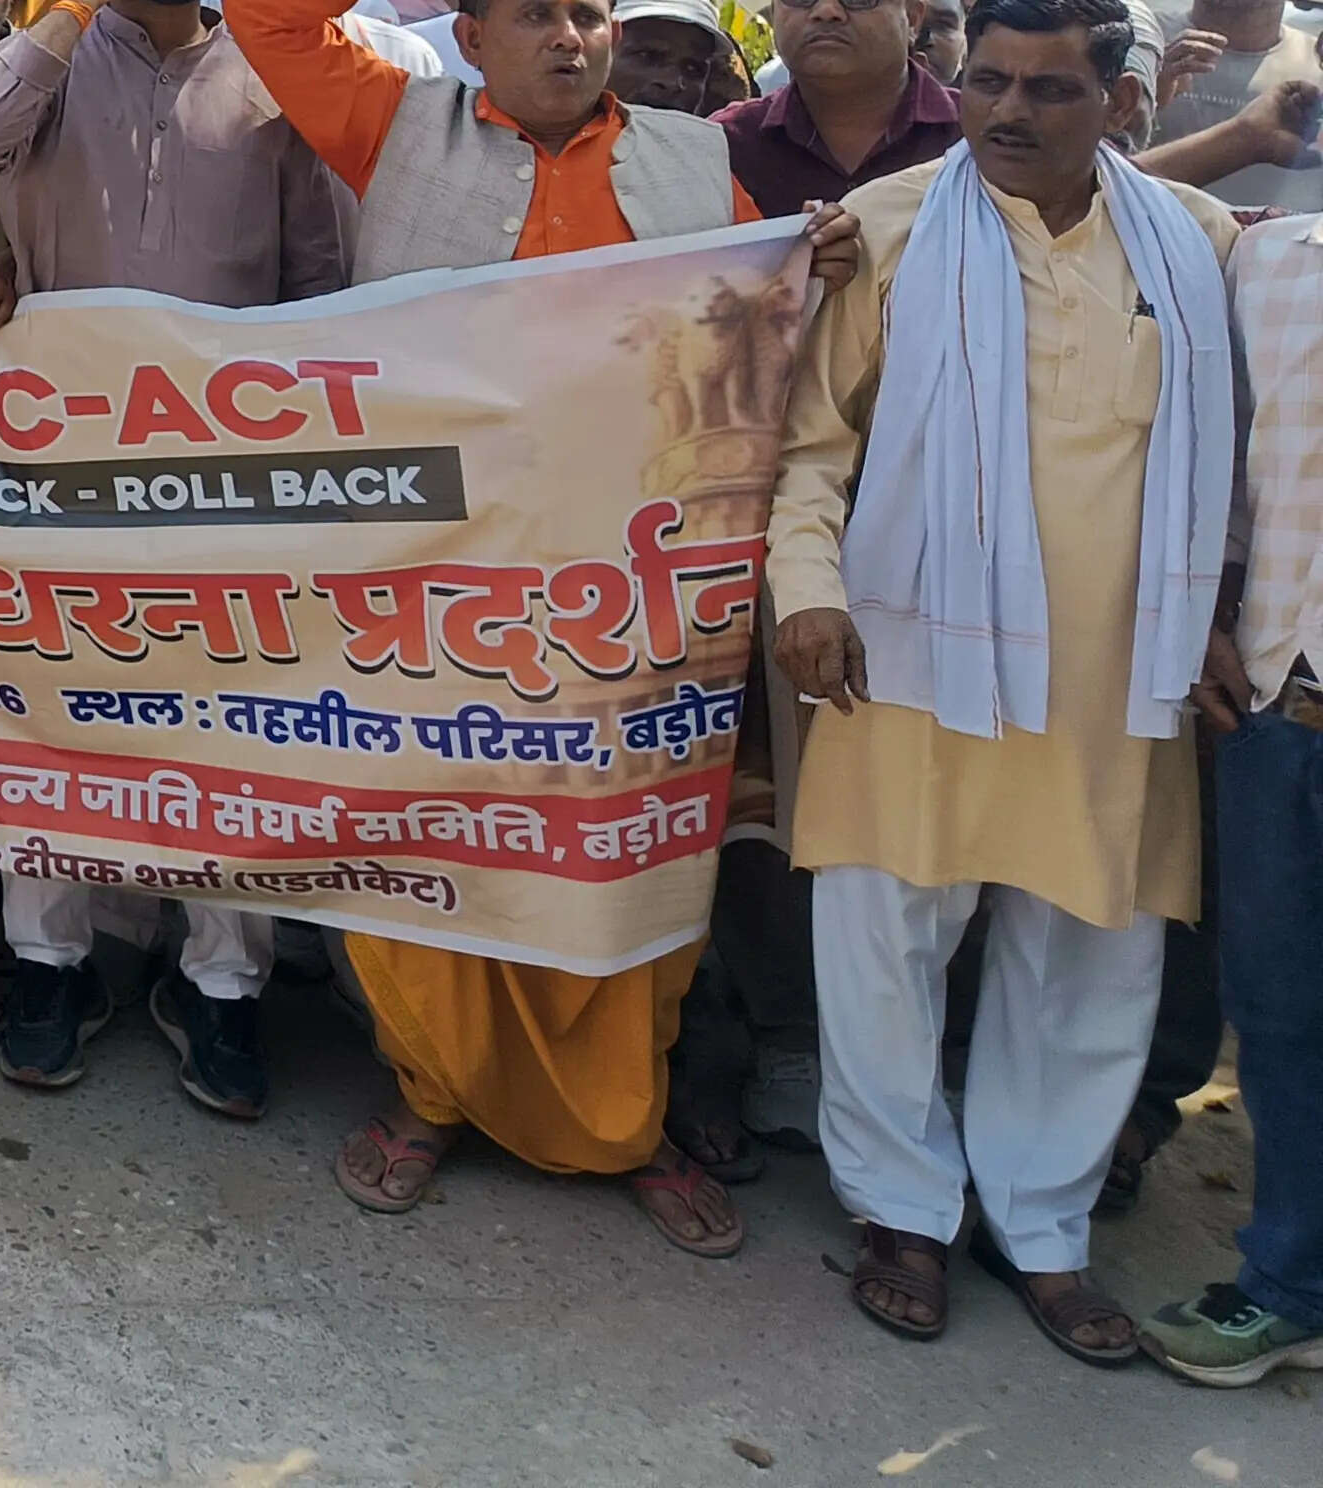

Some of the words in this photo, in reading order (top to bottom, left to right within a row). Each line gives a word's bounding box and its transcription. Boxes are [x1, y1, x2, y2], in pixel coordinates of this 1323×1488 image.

[115, 472, 255, 513] ROLL
[271, 465, 427, 509] BACK
[312, 497, 765, 702] प्रदर्शन
[61, 689, 183, 728] स्थल
[219, 690, 402, 755] तहसील
[413, 704, 613, 770] परिसर,
[621, 684, 745, 757] बड़ौत
[78, 770, 199, 830] जाति
[211, 783, 345, 843] संघर्ष
[356, 799, 566, 862] समिति,
[577, 794, 710, 864] बड़ौत
[10, 835, 125, 885] दीपक
[135, 859, 223, 890] शर्मा
[235, 861, 458, 911] (एडवोकेट)
